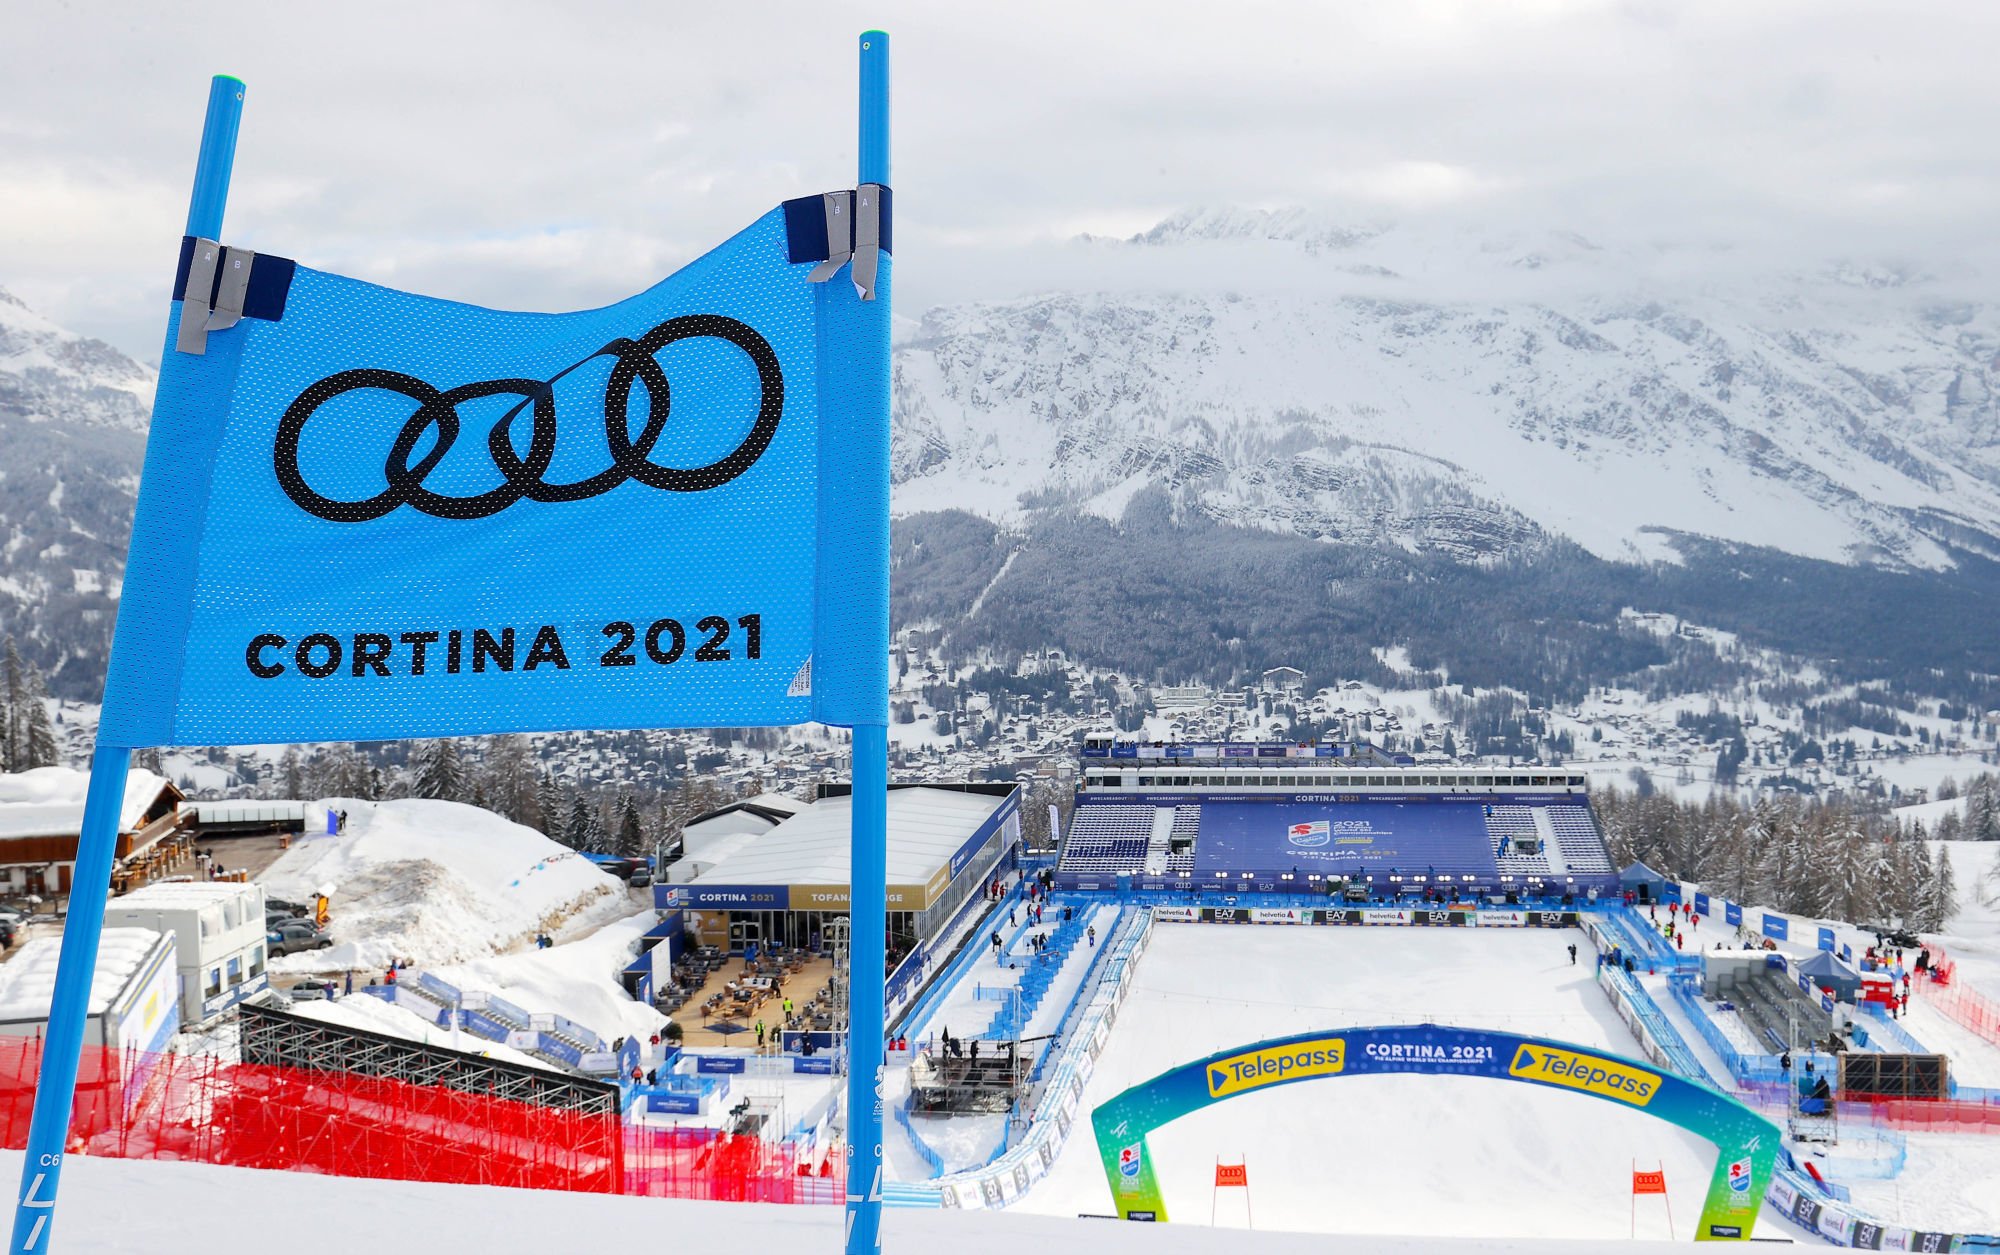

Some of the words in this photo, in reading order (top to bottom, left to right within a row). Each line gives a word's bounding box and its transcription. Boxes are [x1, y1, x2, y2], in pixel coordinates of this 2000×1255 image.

[862, 198, 868, 207] A
[205, 252, 211, 261] A
[234, 260, 241, 269] B
[246, 625, 571, 679] CORTINA
[600, 613, 760, 667] 2021
[700, 893, 747, 902] CORTINA
[751, 893, 774, 902] 2021
[1159, 907, 1185, 916] helvetia
[1215, 908, 1235, 918] EA7
[1326, 911, 1347, 919] EA7
[1428, 912, 1450, 920] EA7
[1541, 913, 1563, 921] EA7
[1366, 1043, 1446, 1058] CORTINA
[1452, 1046, 1493, 1058] 2021
[1229, 1049, 1340, 1082] Telepass
[1542, 1053, 1652, 1097] Telepass
[39, 1153, 60, 1167] C6
